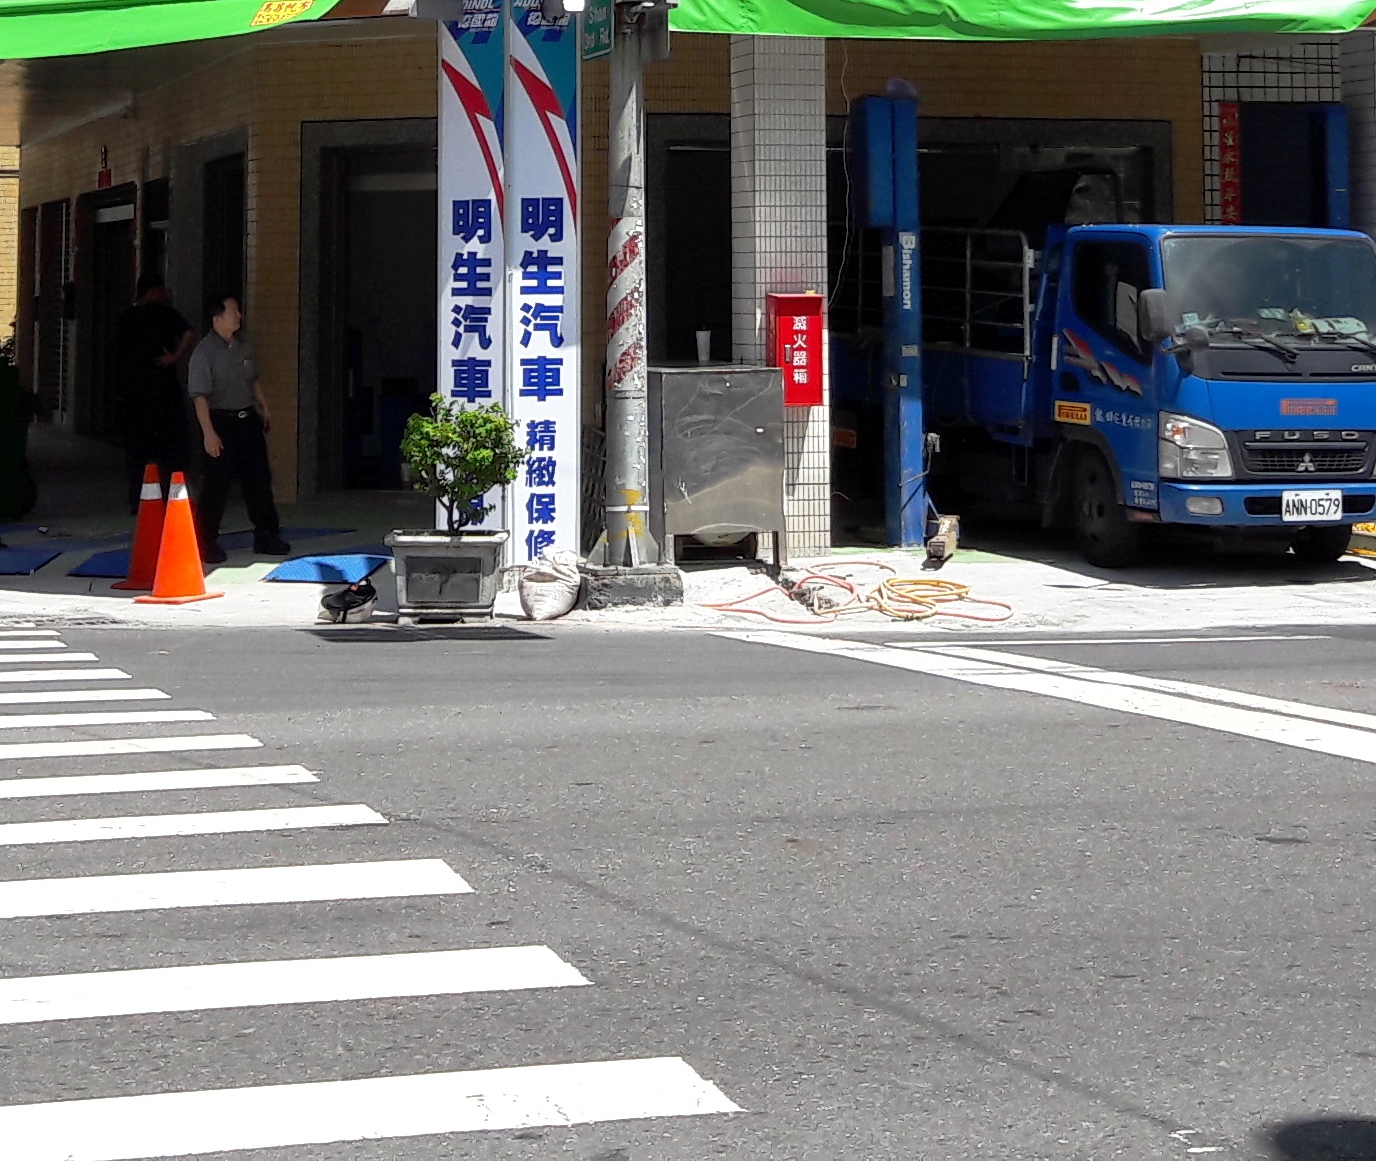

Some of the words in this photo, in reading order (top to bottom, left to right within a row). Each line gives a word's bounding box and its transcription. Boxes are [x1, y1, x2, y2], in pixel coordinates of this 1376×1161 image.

[451, 198, 492, 403] 明生汽車
[519, 197, 564, 402] 明生汽車
[900, 232, 916, 310] Bishamon
[792, 316, 807, 384] 滅火器箱
[1058, 405, 1087, 421] PIRELLI
[1254, 431, 1360, 440] FUSO
[525, 419, 556, 561] 精緻保修
[1284, 498, 1341, 517] ANN-0579
